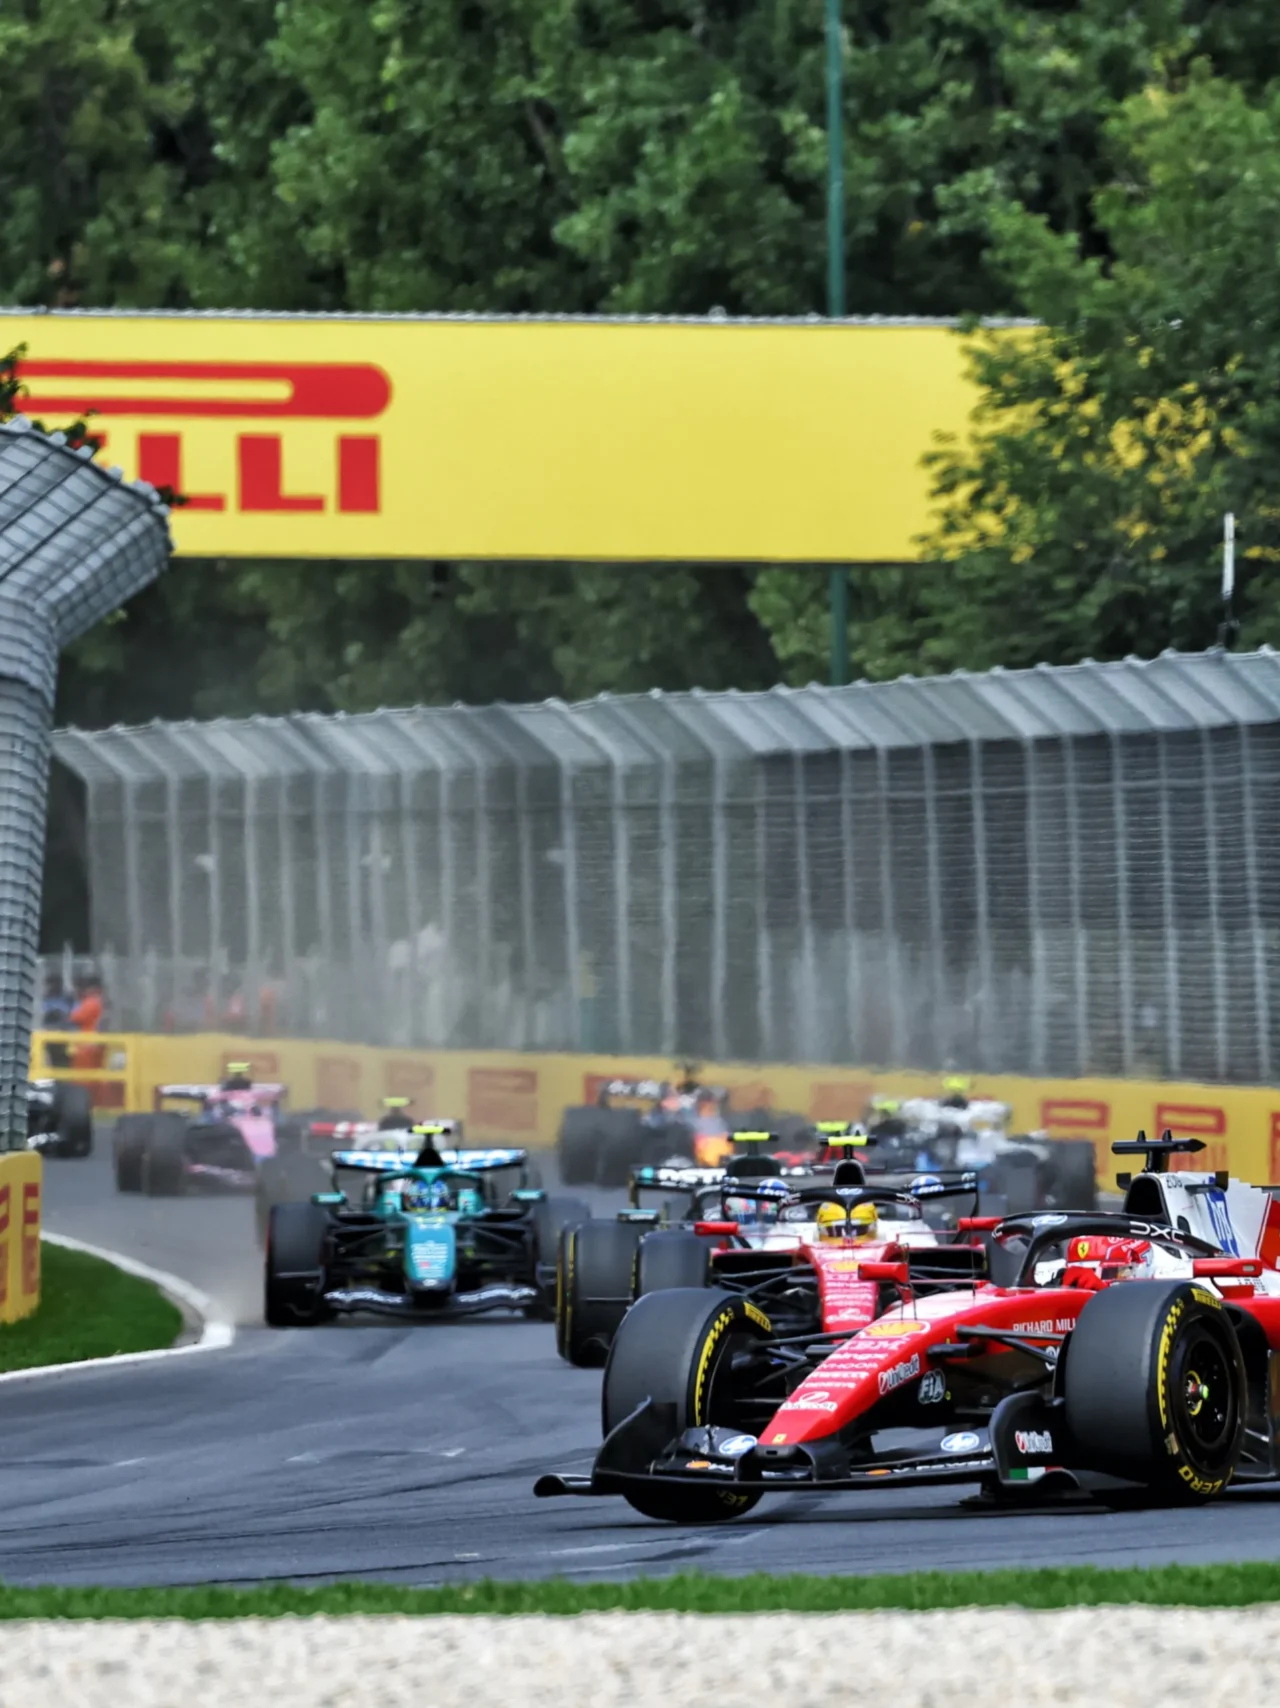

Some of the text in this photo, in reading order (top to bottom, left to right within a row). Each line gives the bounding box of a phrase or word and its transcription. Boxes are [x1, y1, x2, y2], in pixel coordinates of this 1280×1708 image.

[1129, 1220, 1185, 1244] DXC
[1013, 1320, 1054, 1333] RICHARD
[1178, 1464, 1224, 1495] ZERO
